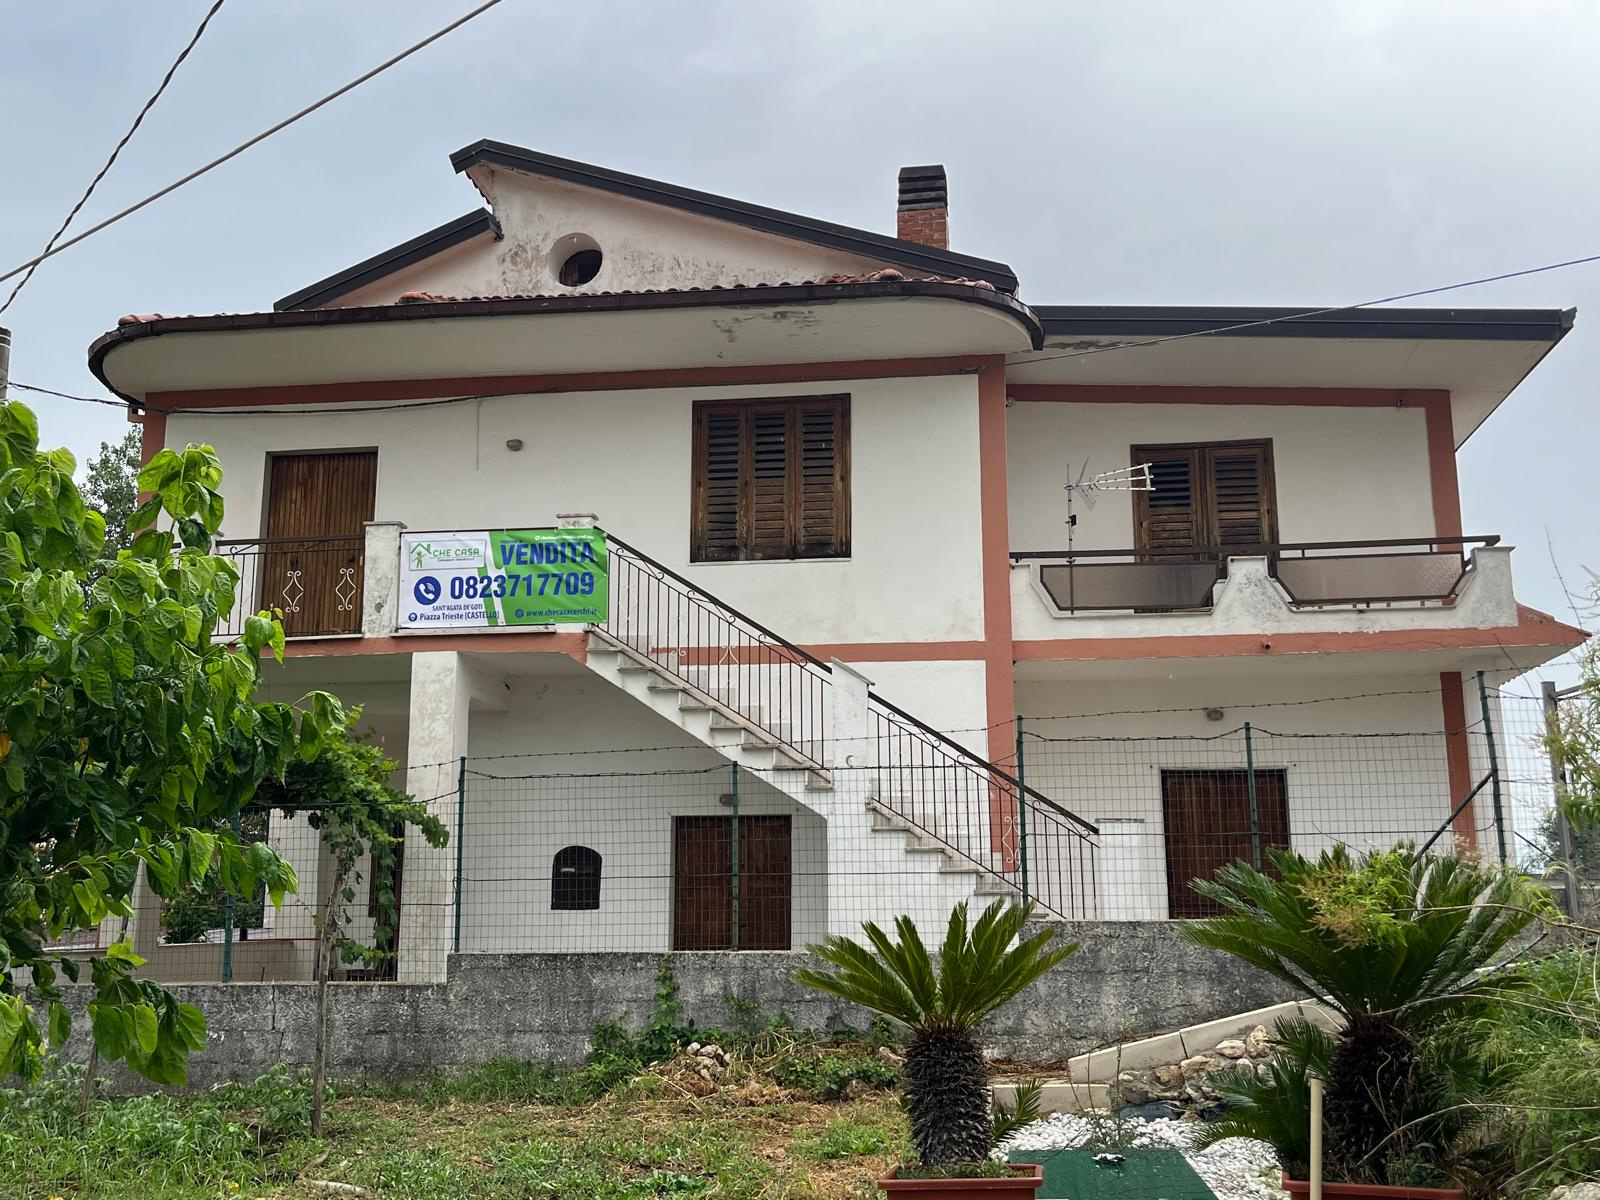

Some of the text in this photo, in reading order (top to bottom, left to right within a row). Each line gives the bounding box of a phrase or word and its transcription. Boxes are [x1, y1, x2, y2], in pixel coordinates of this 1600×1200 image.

[433, 548, 480, 557] CHE CASA
[501, 542, 594, 566] VENDITA
[450, 572, 594, 600] 0823717709
[432, 604, 462, 612] SANT'AGATA
[419, 613, 441, 621] Piazza
[442, 612, 464, 620] Trieste
